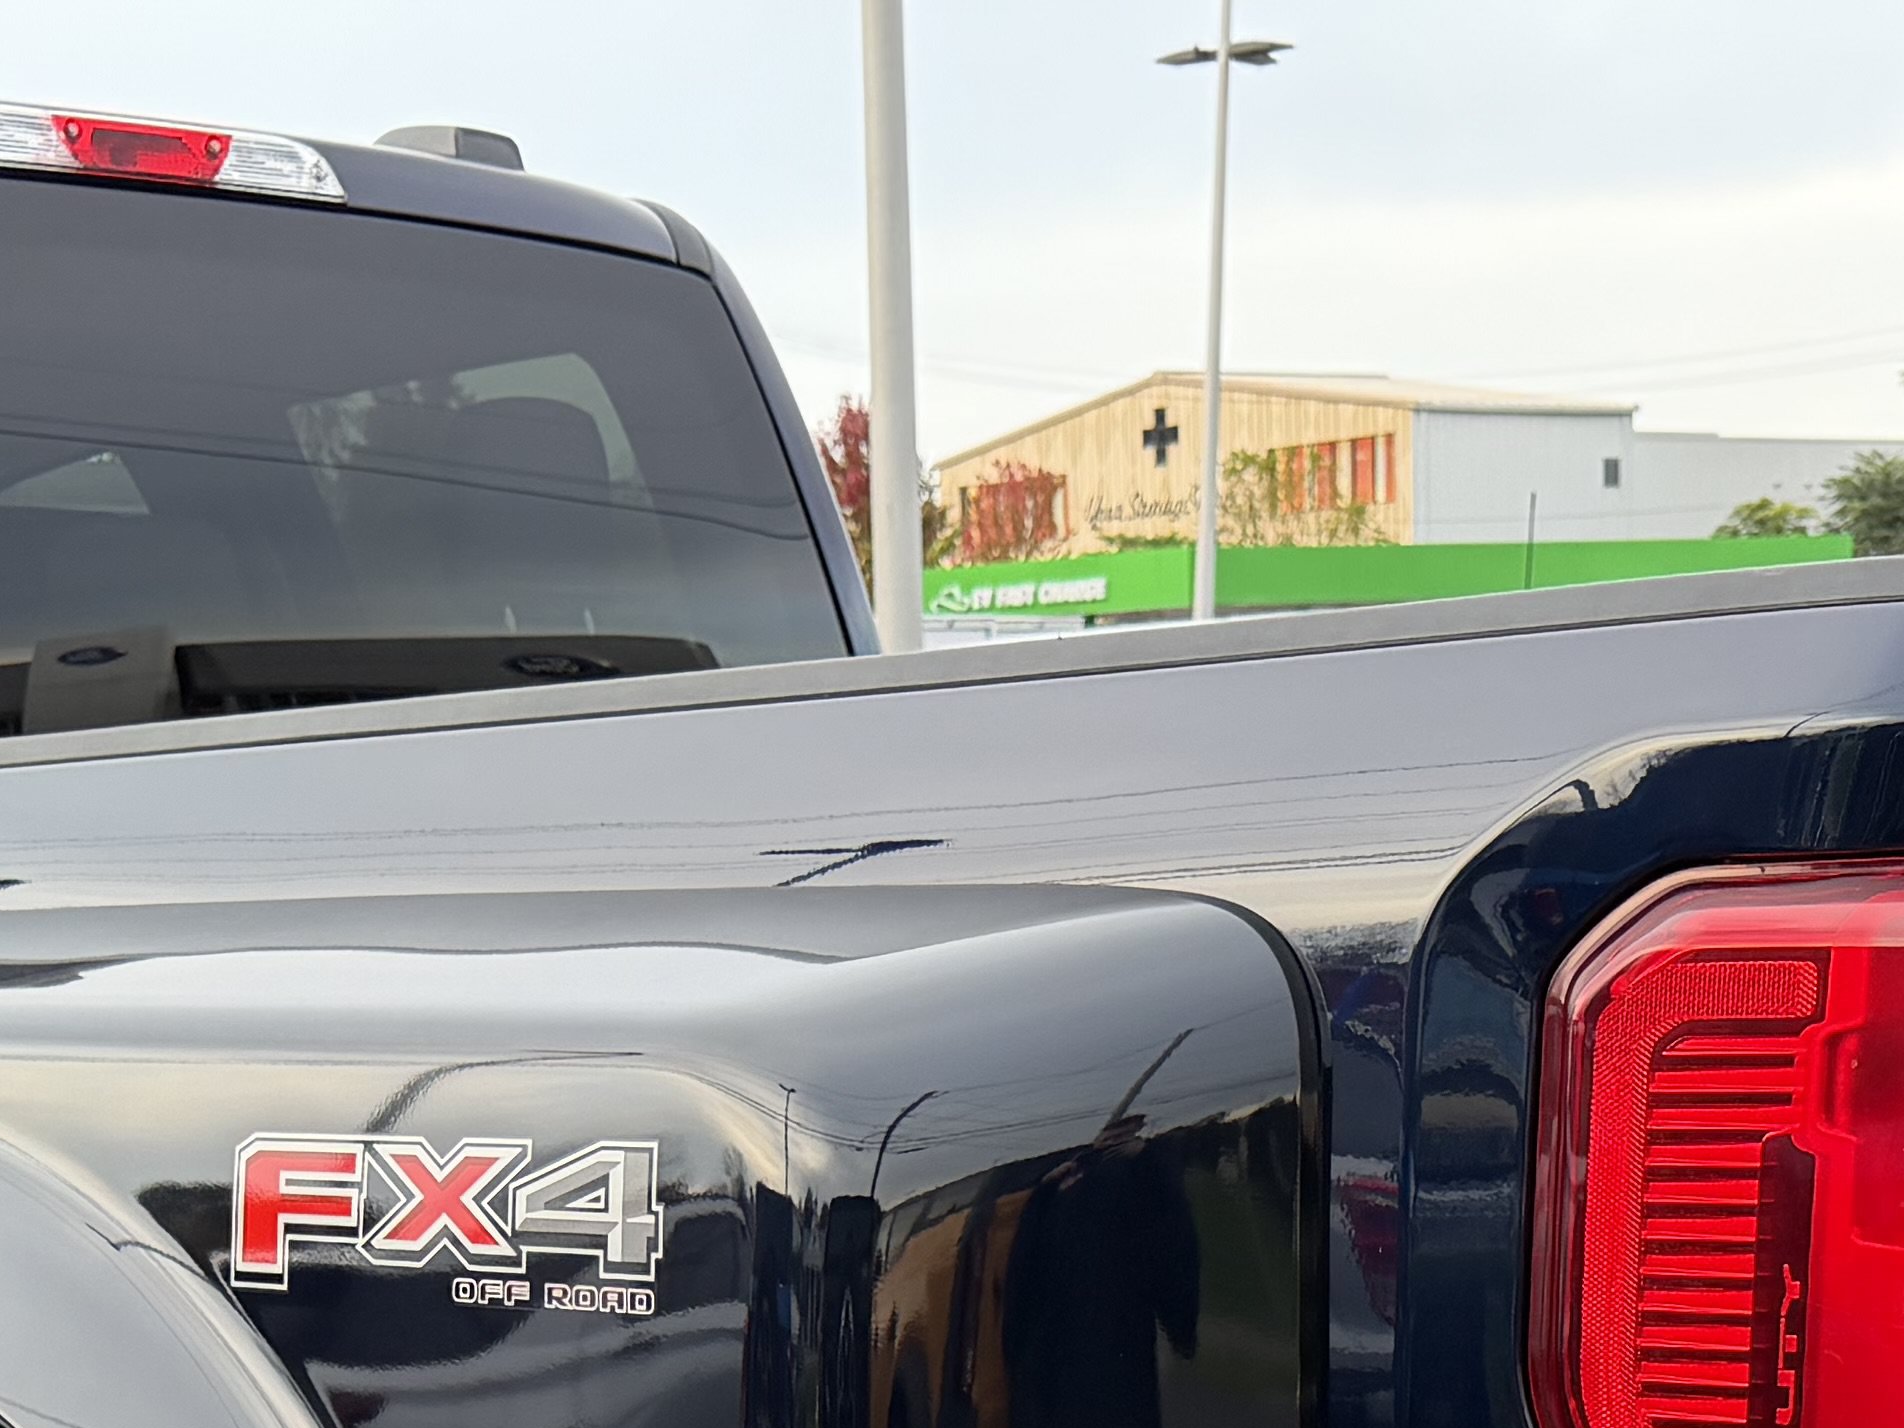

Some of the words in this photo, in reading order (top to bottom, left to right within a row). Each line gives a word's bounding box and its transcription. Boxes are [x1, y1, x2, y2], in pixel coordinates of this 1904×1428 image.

[231, 1132, 664, 1291] FX4
[451, 1278, 531, 1306] OFF
[543, 1284, 656, 1316] ROAD
